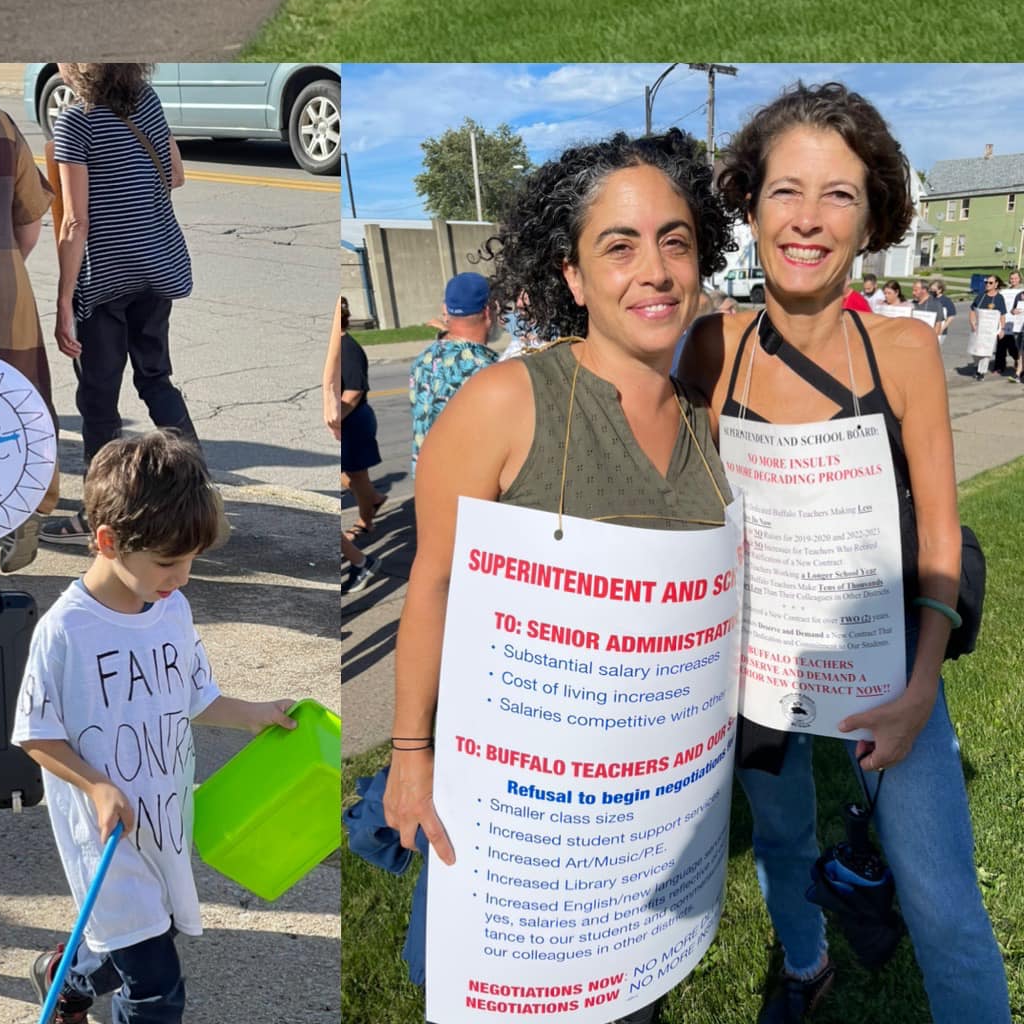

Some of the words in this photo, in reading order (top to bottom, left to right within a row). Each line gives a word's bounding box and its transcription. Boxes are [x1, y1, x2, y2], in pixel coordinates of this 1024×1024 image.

[776, 436, 799, 447] AND
[800, 432, 845, 446] SCHOOL
[753, 469, 816, 485] DEGRADING
[818, 463, 884, 484] PROPOSALS
[759, 455, 785, 469] MORE
[789, 454, 842, 470] INSULTS
[468, 548, 657, 604] SUPERINTENDENT
[661, 580, 708, 604] AND
[494, 611, 522, 635] TO:
[526, 619, 601, 651] SENIOR
[503, 643, 593, 675] Substantial
[598, 662, 651, 681] salary
[655, 650, 721, 677] increases
[748, 645, 792, 664] BUFFALO
[793, 656, 854, 670] TEACHERS
[96, 642, 185, 709] FAIR
[501, 671, 538, 692] Cost
[542, 682, 560, 696] of
[563, 684, 608, 706] living
[613, 685, 692, 704] increases
[766, 675, 788, 688] NEW
[791, 681, 853, 696] CONTRACT
[782, 667, 805, 679] AND
[806, 670, 857, 683] DEMAND
[858, 673, 867, 683] A
[499, 697, 563, 724] Salaries
[567, 711, 667, 731] competitive
[670, 705, 700, 724] with
[455, 735, 482, 758] TO:
[485, 746, 567, 777] BUFFALO
[571, 756, 670, 779] TEACHERS
[673, 742, 705, 769] AND
[706, 723, 727, 752] OUR
[507, 779, 573, 805] Refusal
[578, 790, 597, 805] to
[602, 787, 651, 806] begin
[655, 747, 727, 798] negotiations
[489, 822, 562, 847] Increased
[566, 833, 626, 848] student
[630, 816, 682, 843] support
[683, 789, 722, 823] services
[490, 797, 546, 823] Smaller
[550, 807, 592, 825] class
[594, 811, 635, 825] sizes
[488, 845, 562, 869] Increased
[565, 842, 669, 870] Art/Music/P.E.
[486, 869, 560, 891] Increased
[564, 873, 618, 894] Library
[621, 857, 676, 885] services
[484, 911, 515, 928] yes,
[519, 915, 577, 929] salaries
[581, 911, 610, 928] and
[613, 895, 666, 923] benefits
[485, 892, 559, 913] Increased
[563, 886, 651, 914] English/new
[484, 927, 526, 945] tance
[529, 931, 546, 946] to
[549, 934, 575, 946] our
[578, 920, 641, 942] students
[643, 906, 668, 927] and
[483, 945, 508, 958] our
[512, 947, 593, 964] colleagues
[596, 942, 610, 955] in
[613, 931, 649, 952] other
[465, 996, 580, 1016] NEGOTIATIONS
[584, 989, 621, 1009] NOW
[629, 974, 654, 994] NO
[468, 979, 583, 999] NEGOTIATIONS
[633, 957, 658, 978] NO
